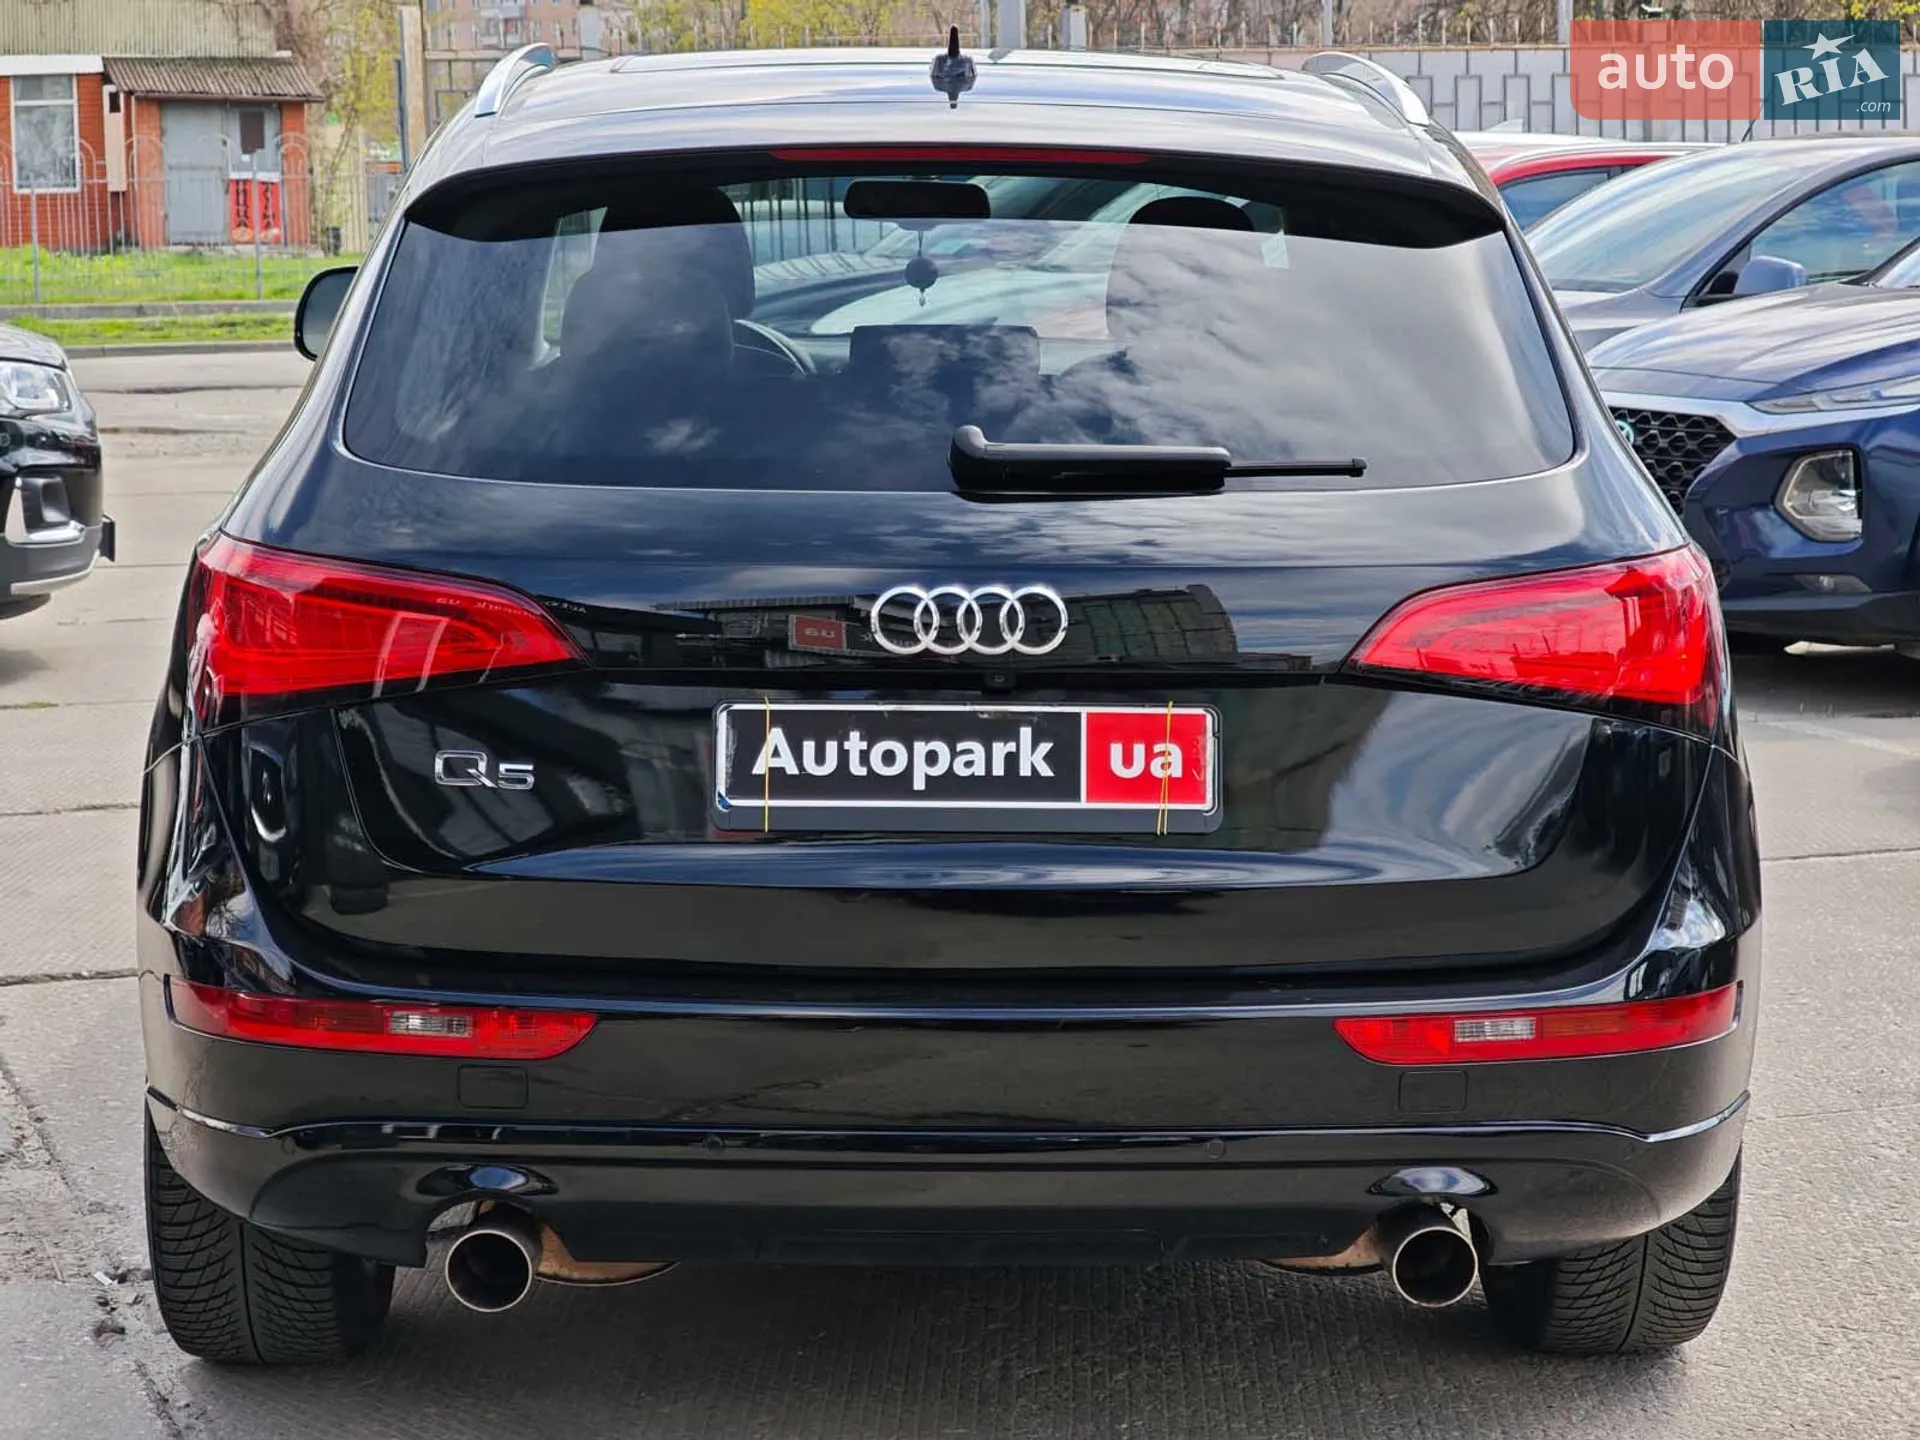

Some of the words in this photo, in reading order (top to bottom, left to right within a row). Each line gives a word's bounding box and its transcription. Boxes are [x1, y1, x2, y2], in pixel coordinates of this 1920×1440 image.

[434, 749, 535, 790] Q5
[751, 726, 1055, 791] Autopark
[1109, 741, 1184, 780] ua
